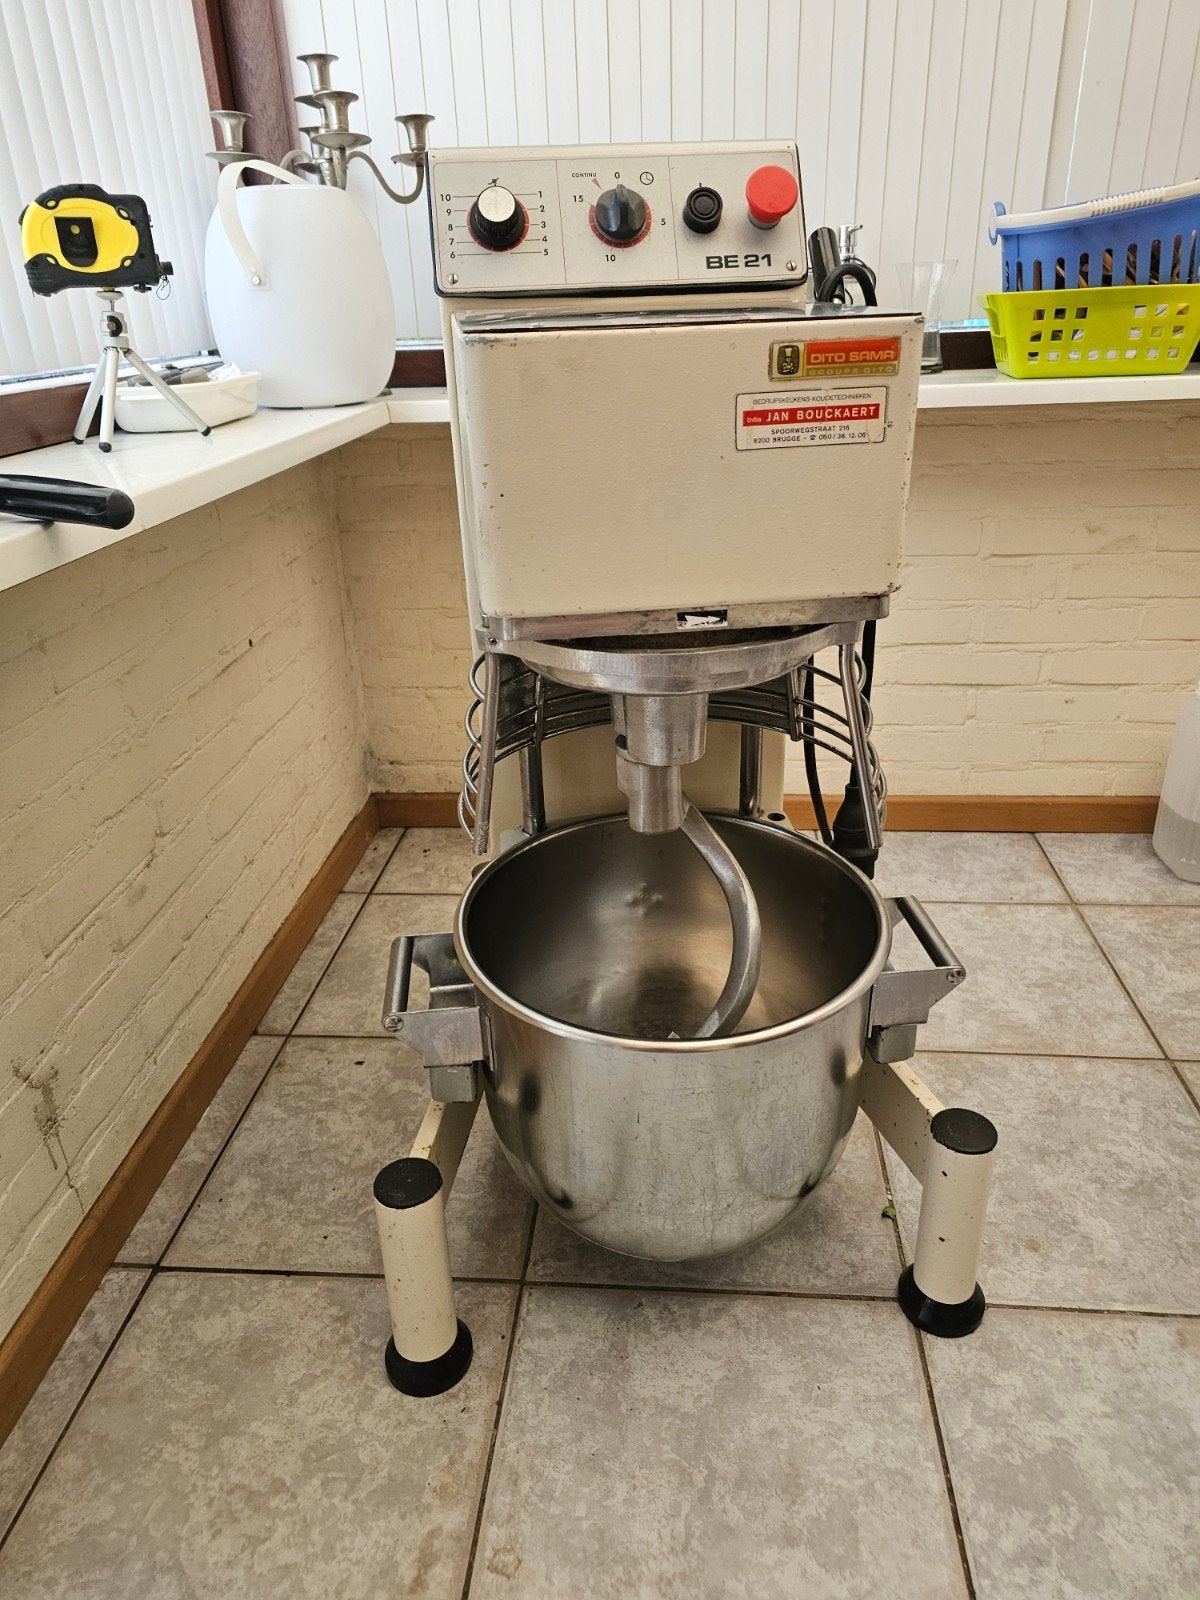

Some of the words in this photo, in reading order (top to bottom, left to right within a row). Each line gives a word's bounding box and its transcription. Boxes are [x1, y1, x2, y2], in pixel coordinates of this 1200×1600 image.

[614, 171, 620, 179] 0
[440, 194, 451, 202] 10
[538, 190, 543, 198] 1
[573, 195, 584, 203] 15
[446, 208, 452, 216] 9
[660, 218, 666, 226] 5
[542, 235, 548, 243] 4
[450, 251, 455, 259] 6
[605, 254, 616, 262] 10
[705, 254, 739, 269] BE
[744, 253, 772, 268] 21
[810, 352, 846, 364] DITO
[849, 349, 895, 362] SAMA
[863, 366, 893, 374] DITO
[766, 411, 789, 422] JAN
[796, 406, 876, 421] BOUCKAERT
[770, 425, 836, 435] SPOORWEGSTRAAT
[772, 435, 801, 443] BRUGGE
